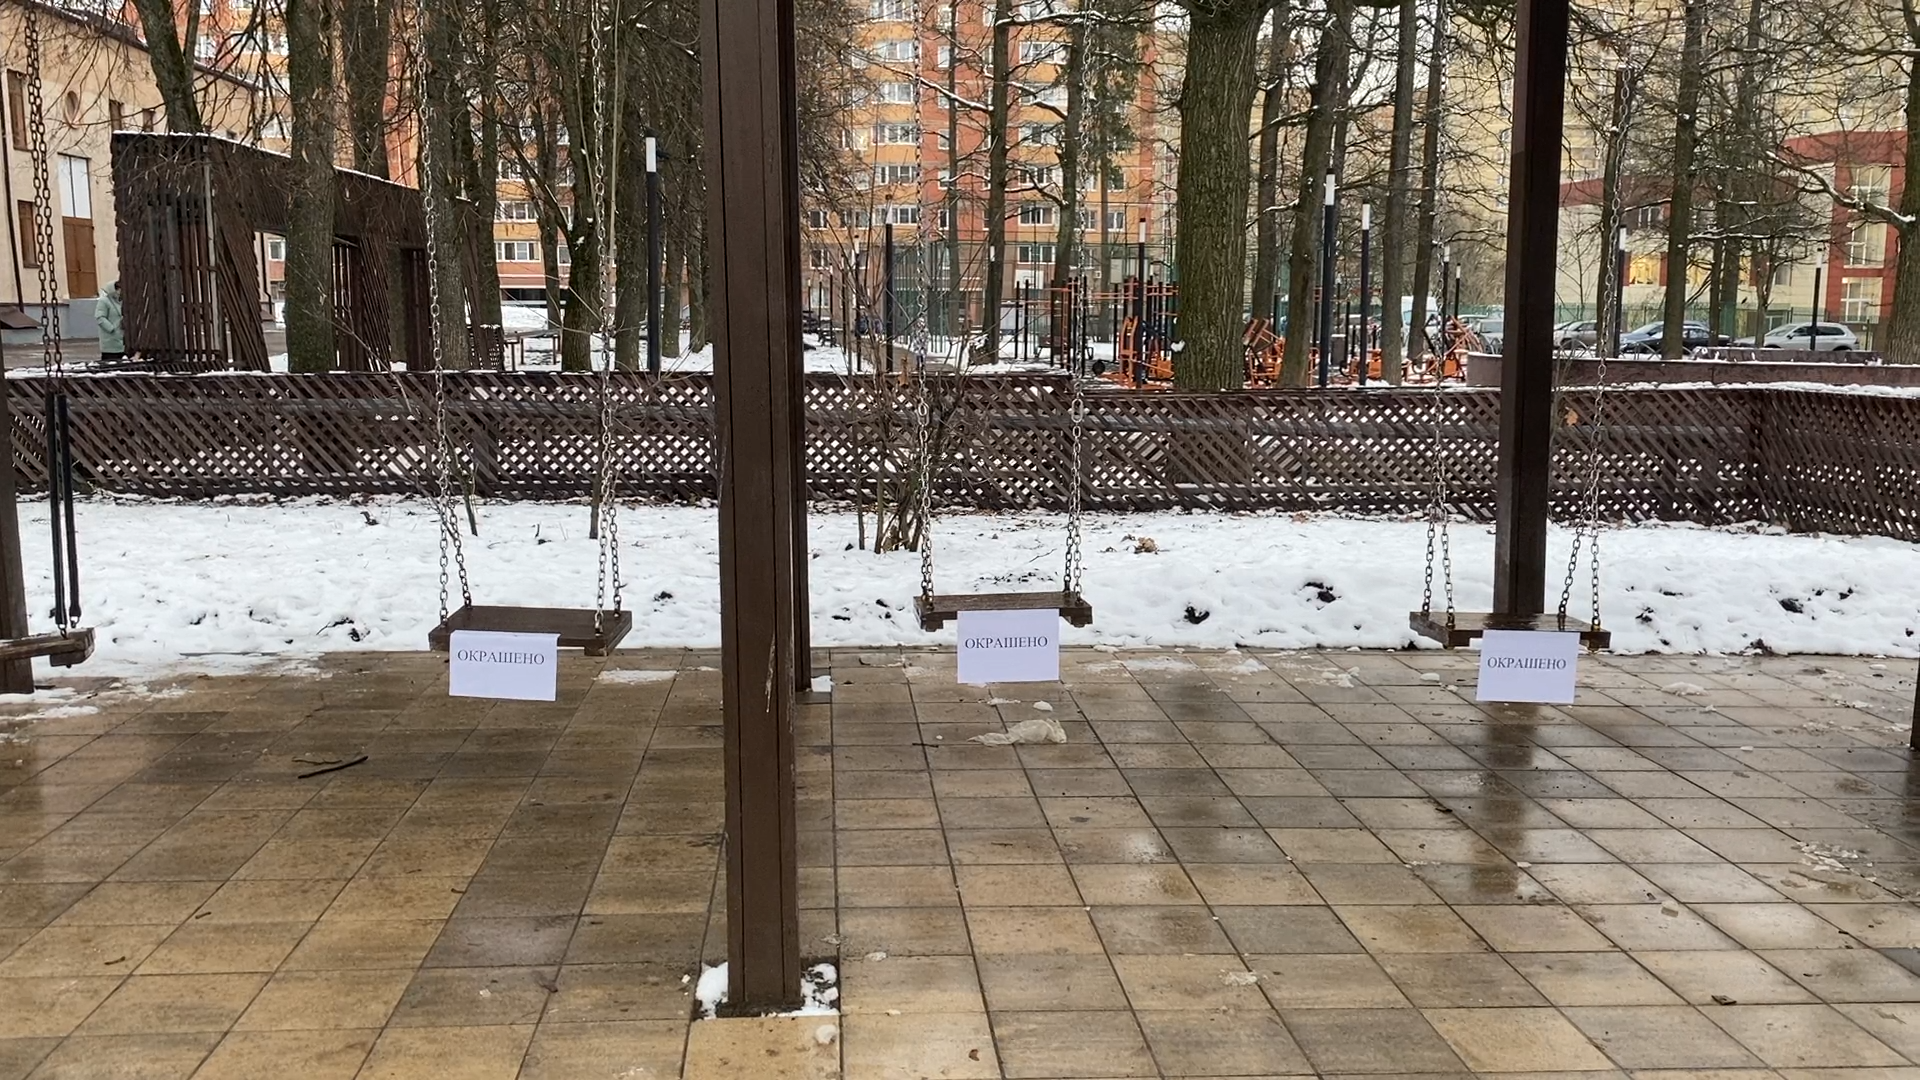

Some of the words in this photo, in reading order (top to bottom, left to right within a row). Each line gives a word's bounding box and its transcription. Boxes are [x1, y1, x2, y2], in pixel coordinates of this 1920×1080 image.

[965, 636, 1048, 649] ОКРАШЕНО
[457, 650, 545, 665] ОКРАШЕНО
[1487, 657, 1567, 670] ОКРАШЕНО
